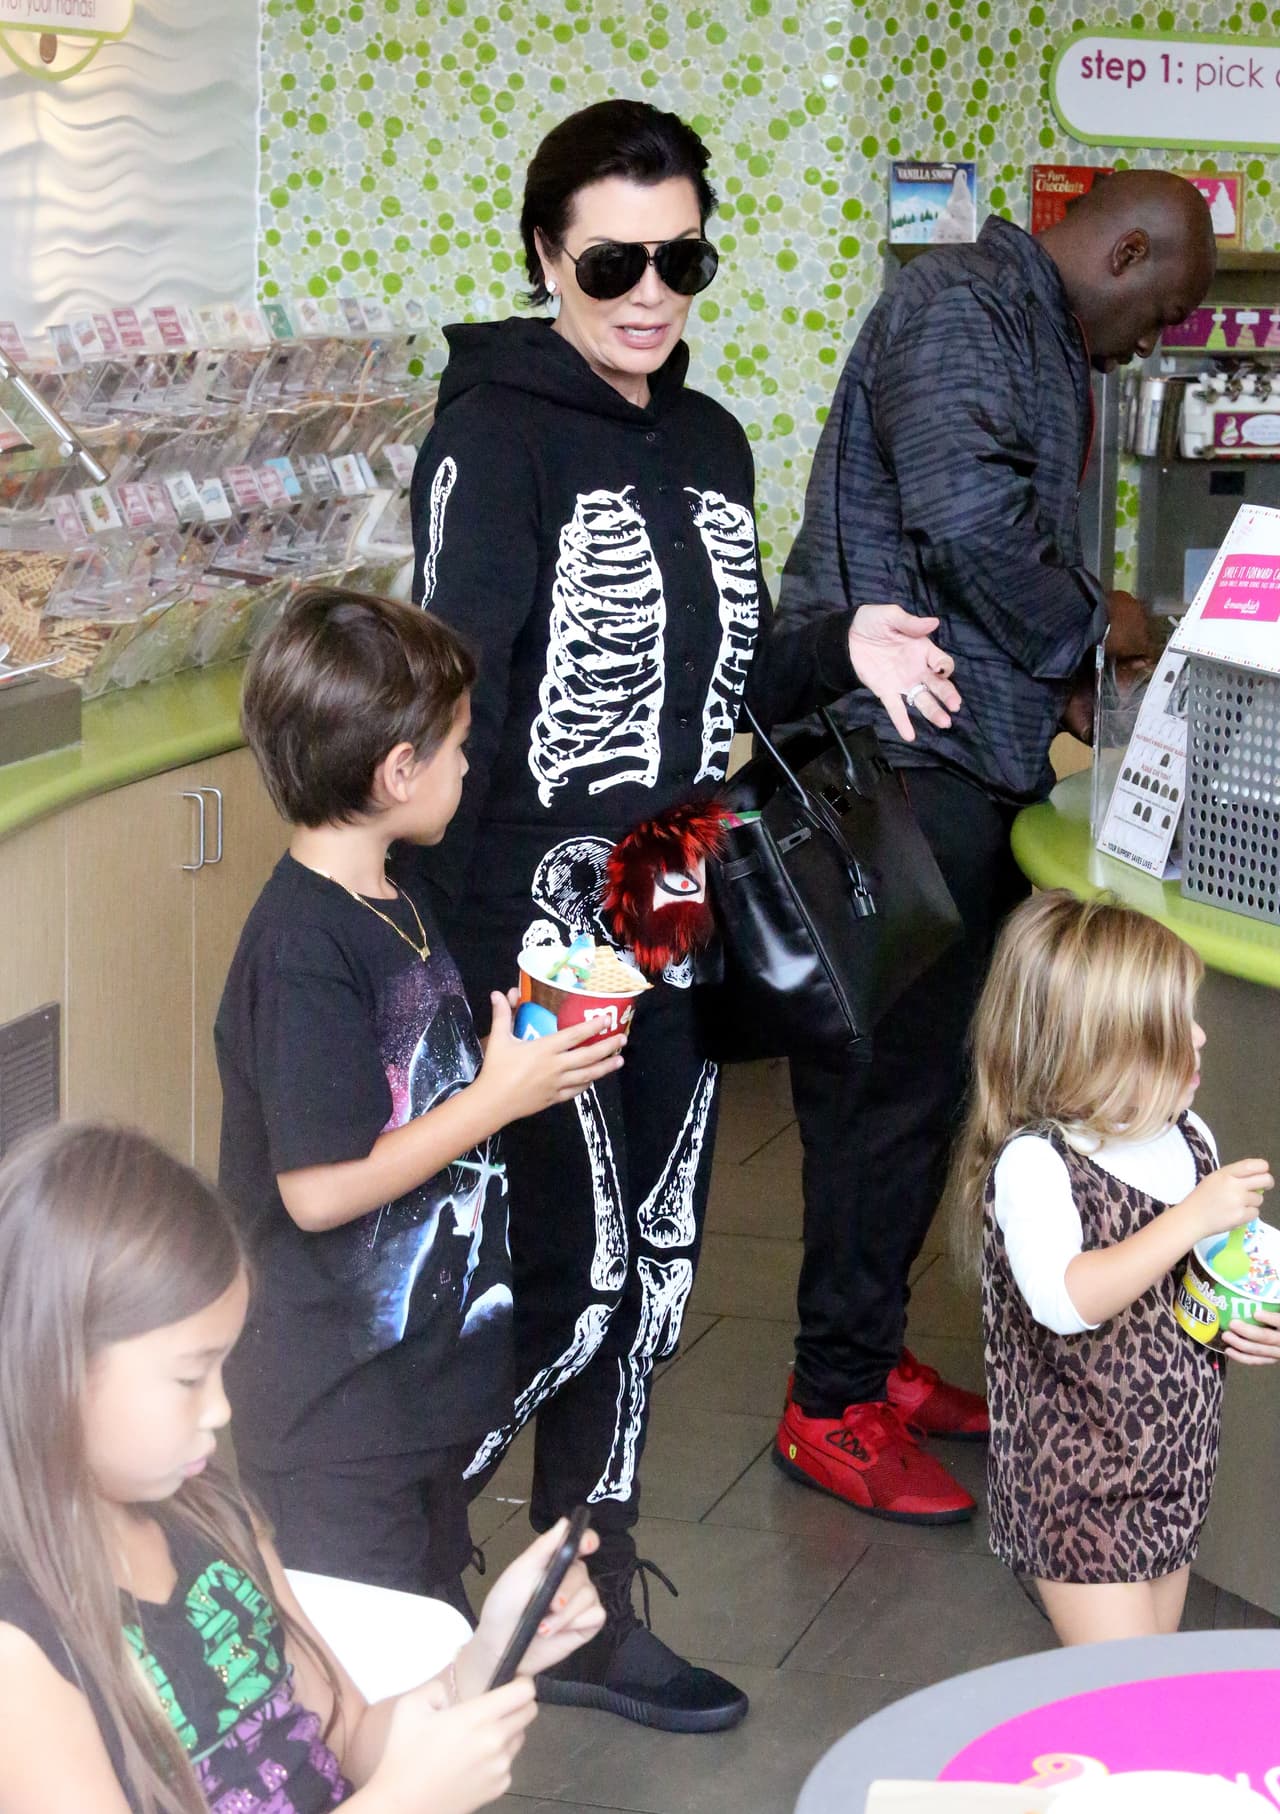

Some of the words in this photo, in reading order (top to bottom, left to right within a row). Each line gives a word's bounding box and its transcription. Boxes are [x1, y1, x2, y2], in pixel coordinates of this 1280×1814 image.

[1081, 49, 1146, 89] step
[1160, 53, 1184, 85] 1:
[1196, 55, 1264, 92] pick
[897, 167, 930, 181] VANILLA
[1036, 178, 1085, 193] Chocolate
